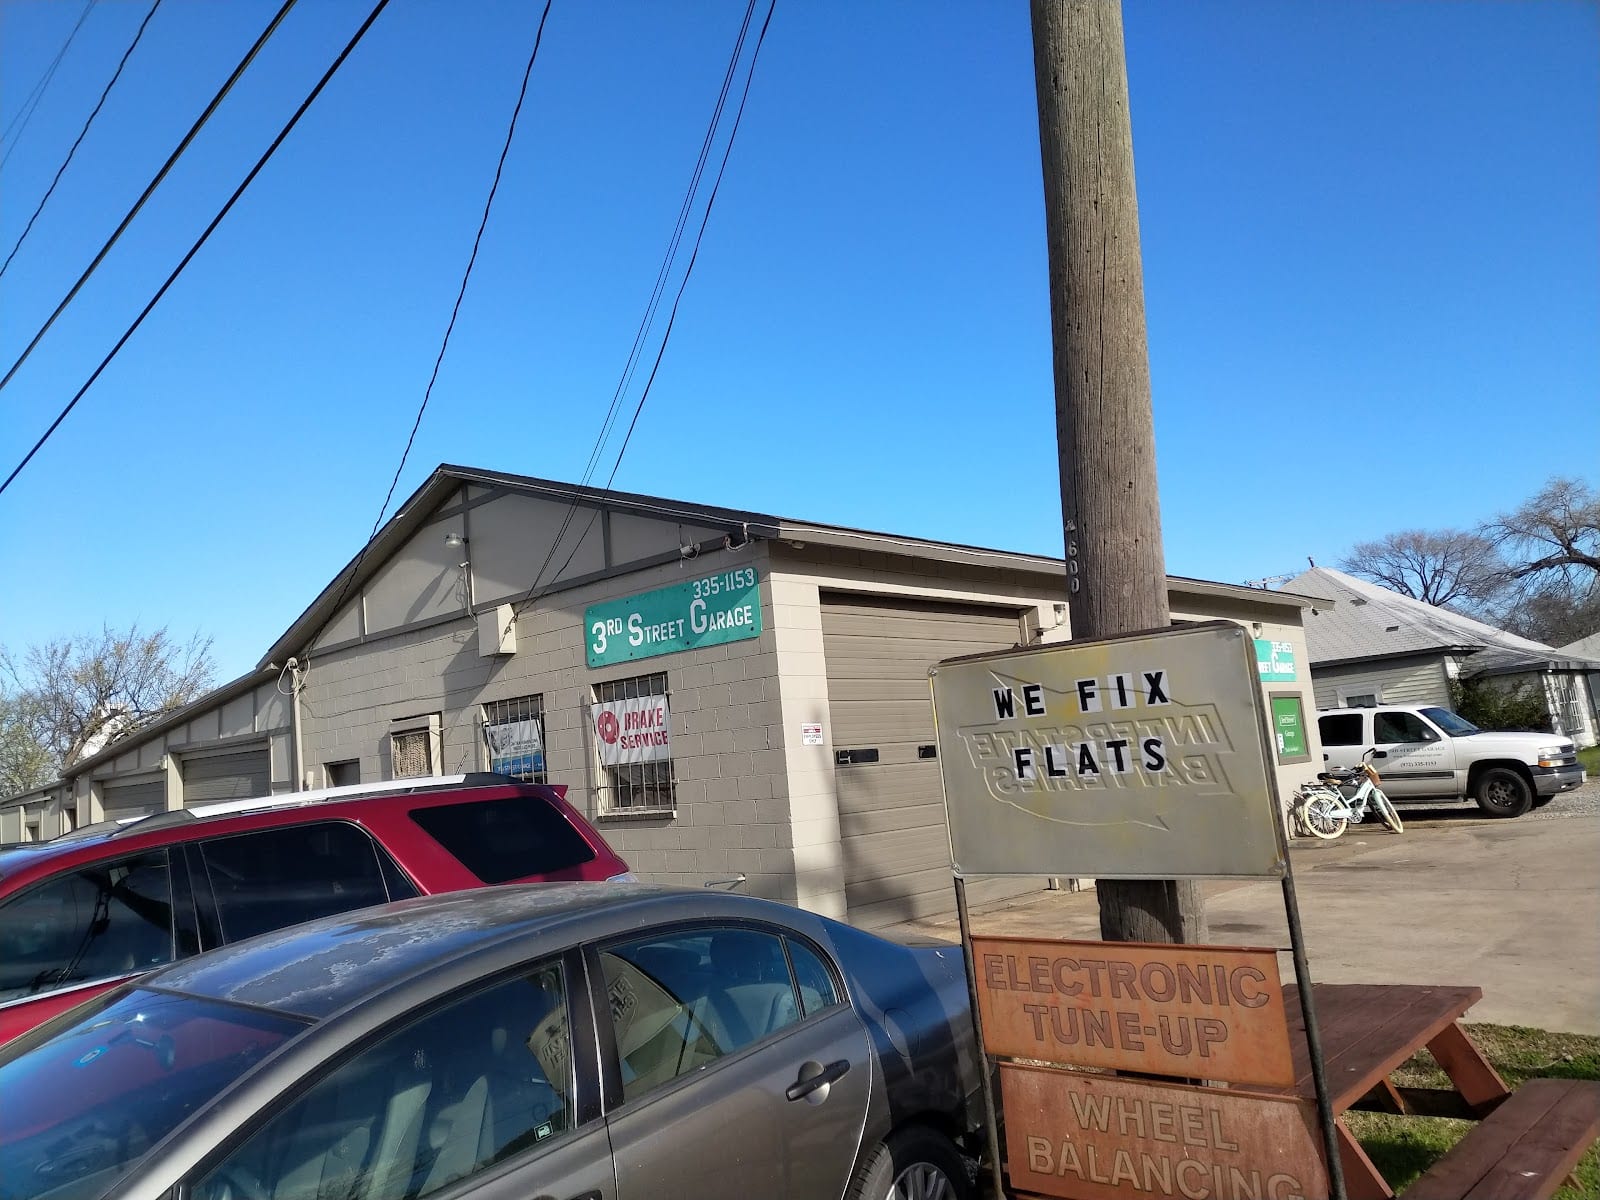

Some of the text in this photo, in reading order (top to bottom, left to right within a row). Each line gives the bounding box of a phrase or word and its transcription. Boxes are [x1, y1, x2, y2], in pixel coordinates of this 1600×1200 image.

[693, 568, 754, 598] 335-1153
[592, 617, 622, 654] 3RD
[993, 671, 1168, 719] WE FIX
[620, 730, 668, 749] SERVICE
[624, 708, 663, 731] BRAKE
[1014, 738, 1166, 779] FLATS
[983, 953, 1270, 1008] ELECTRONIC
[1023, 1004, 1228, 1057] TUNE-UP
[1069, 1091, 1240, 1152] WHEEL
[1027, 1135, 1304, 1200] BALANCING
